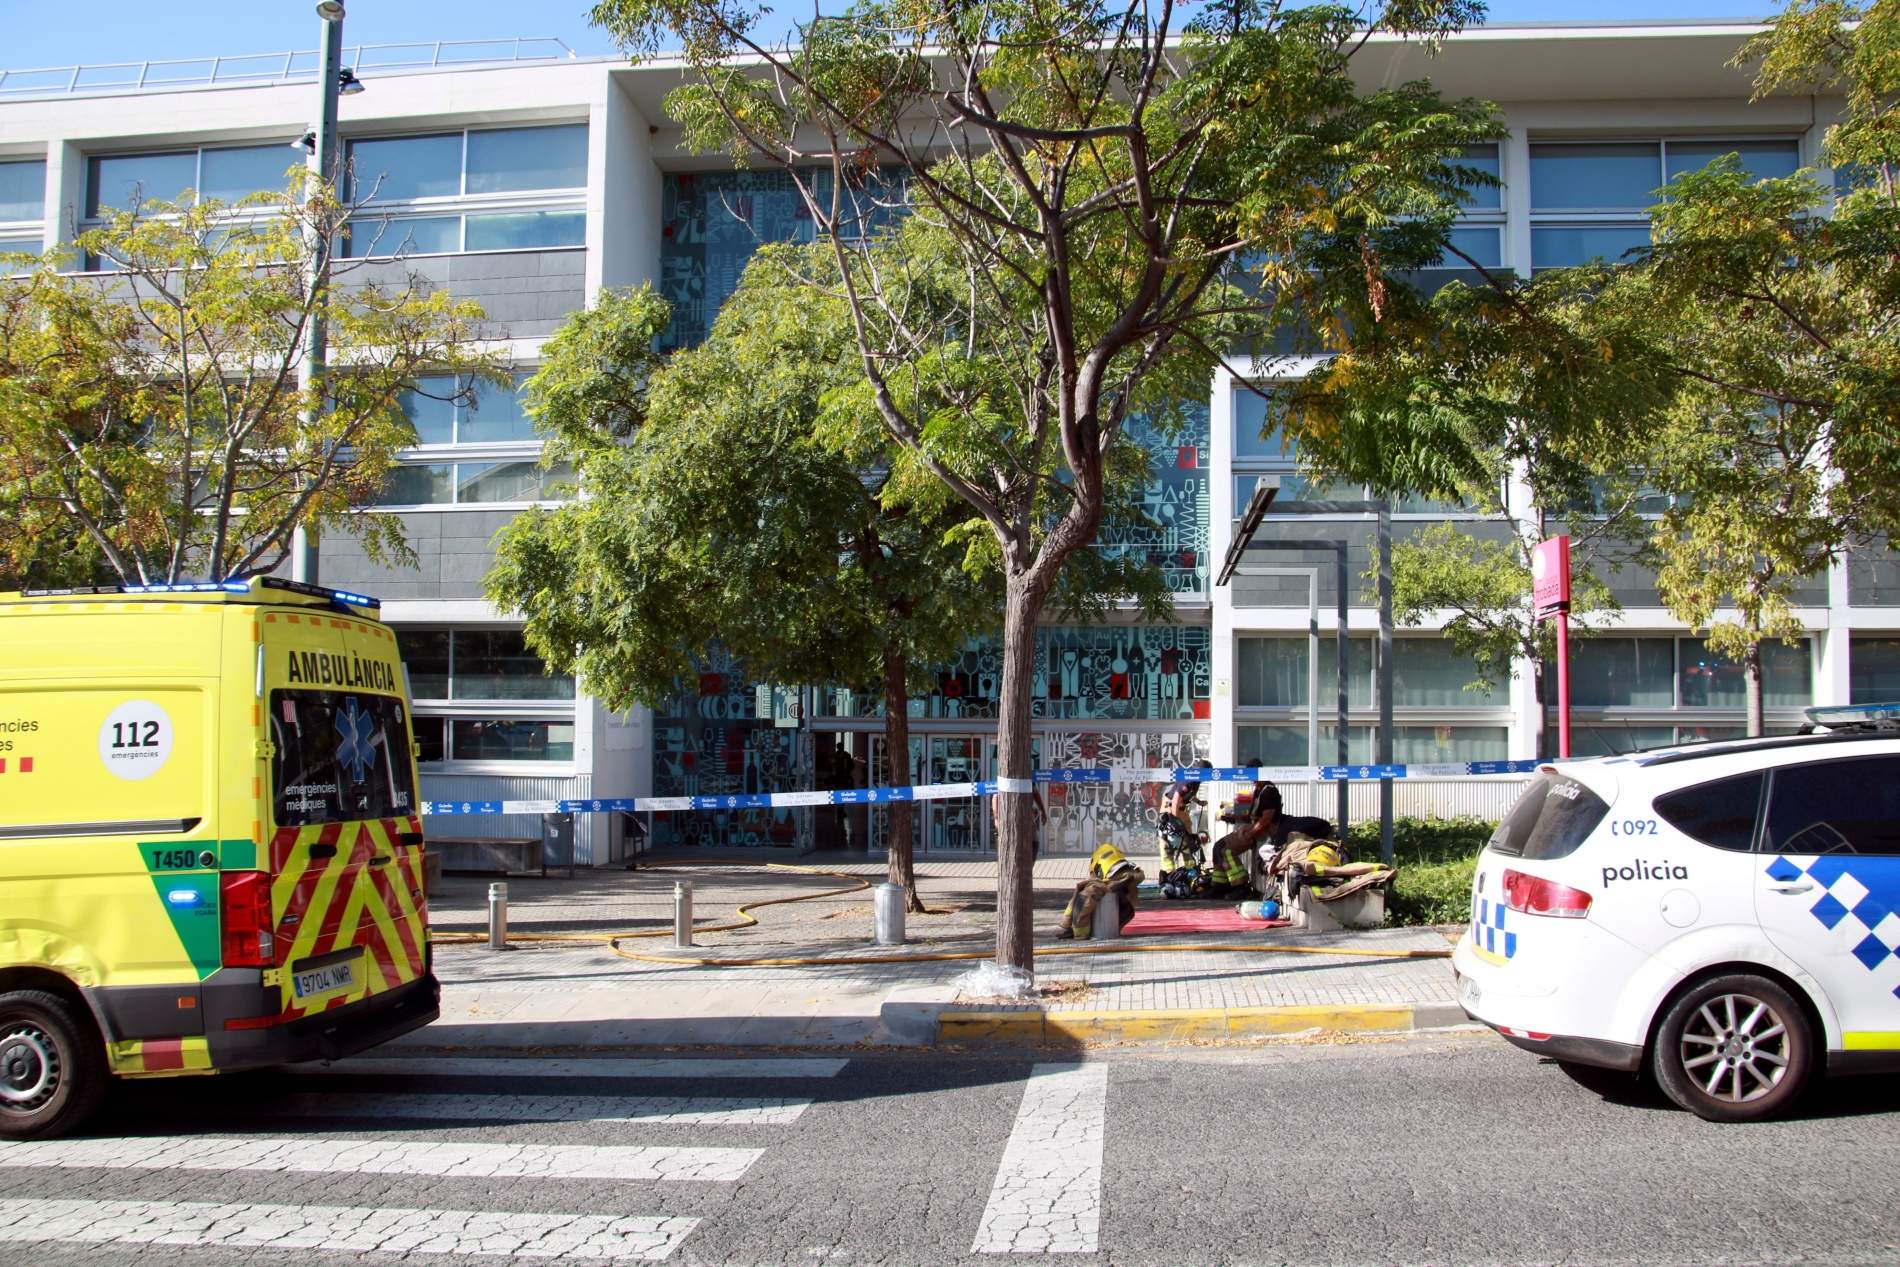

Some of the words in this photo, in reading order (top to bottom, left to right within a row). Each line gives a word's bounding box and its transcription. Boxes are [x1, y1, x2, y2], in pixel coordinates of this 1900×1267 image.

[288, 650, 396, 692] AMBULÀNCIA
[1195, 678, 1208, 687] Ca
[112, 720, 159, 748] 112
[1546, 781, 1581, 801] policia
[1623, 820, 1658, 836] 092
[153, 850, 195, 869] T450
[1602, 858, 1689, 889] policia
[302, 971, 330, 993] 9704
